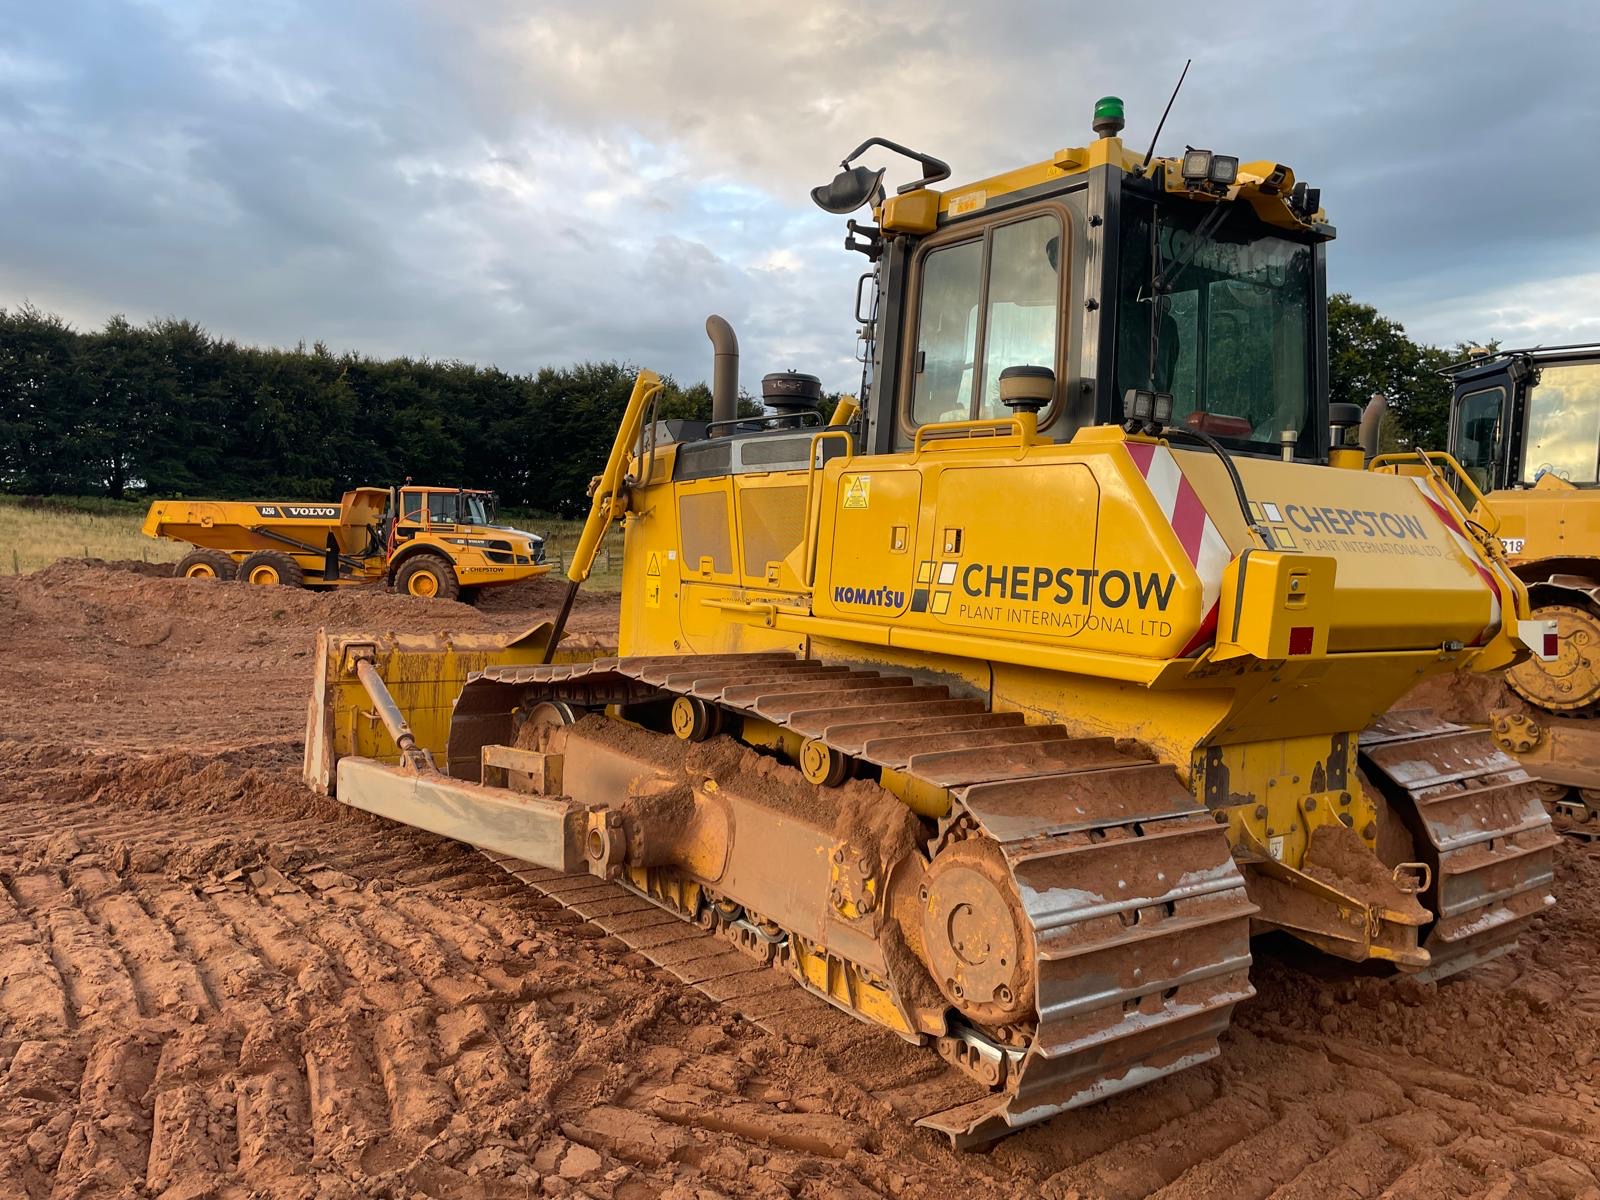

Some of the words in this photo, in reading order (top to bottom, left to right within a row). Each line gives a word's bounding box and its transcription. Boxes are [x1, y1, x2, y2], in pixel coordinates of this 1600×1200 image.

[289, 507, 335, 516] VOLVO
[1284, 504, 1428, 541] CHEPSTOW
[1303, 538, 1338, 552] PLANT
[1342, 541, 1424, 557] INTERNATIONAL
[1421, 545, 1443, 557] LTD
[834, 585, 905, 609] KOMATSU
[962, 563, 1176, 612] CHEPSTOW
[959, 604, 1001, 621] PLANT
[1007, 608, 1134, 635] INTERNATIONAL
[1140, 620, 1172, 638] LTD
